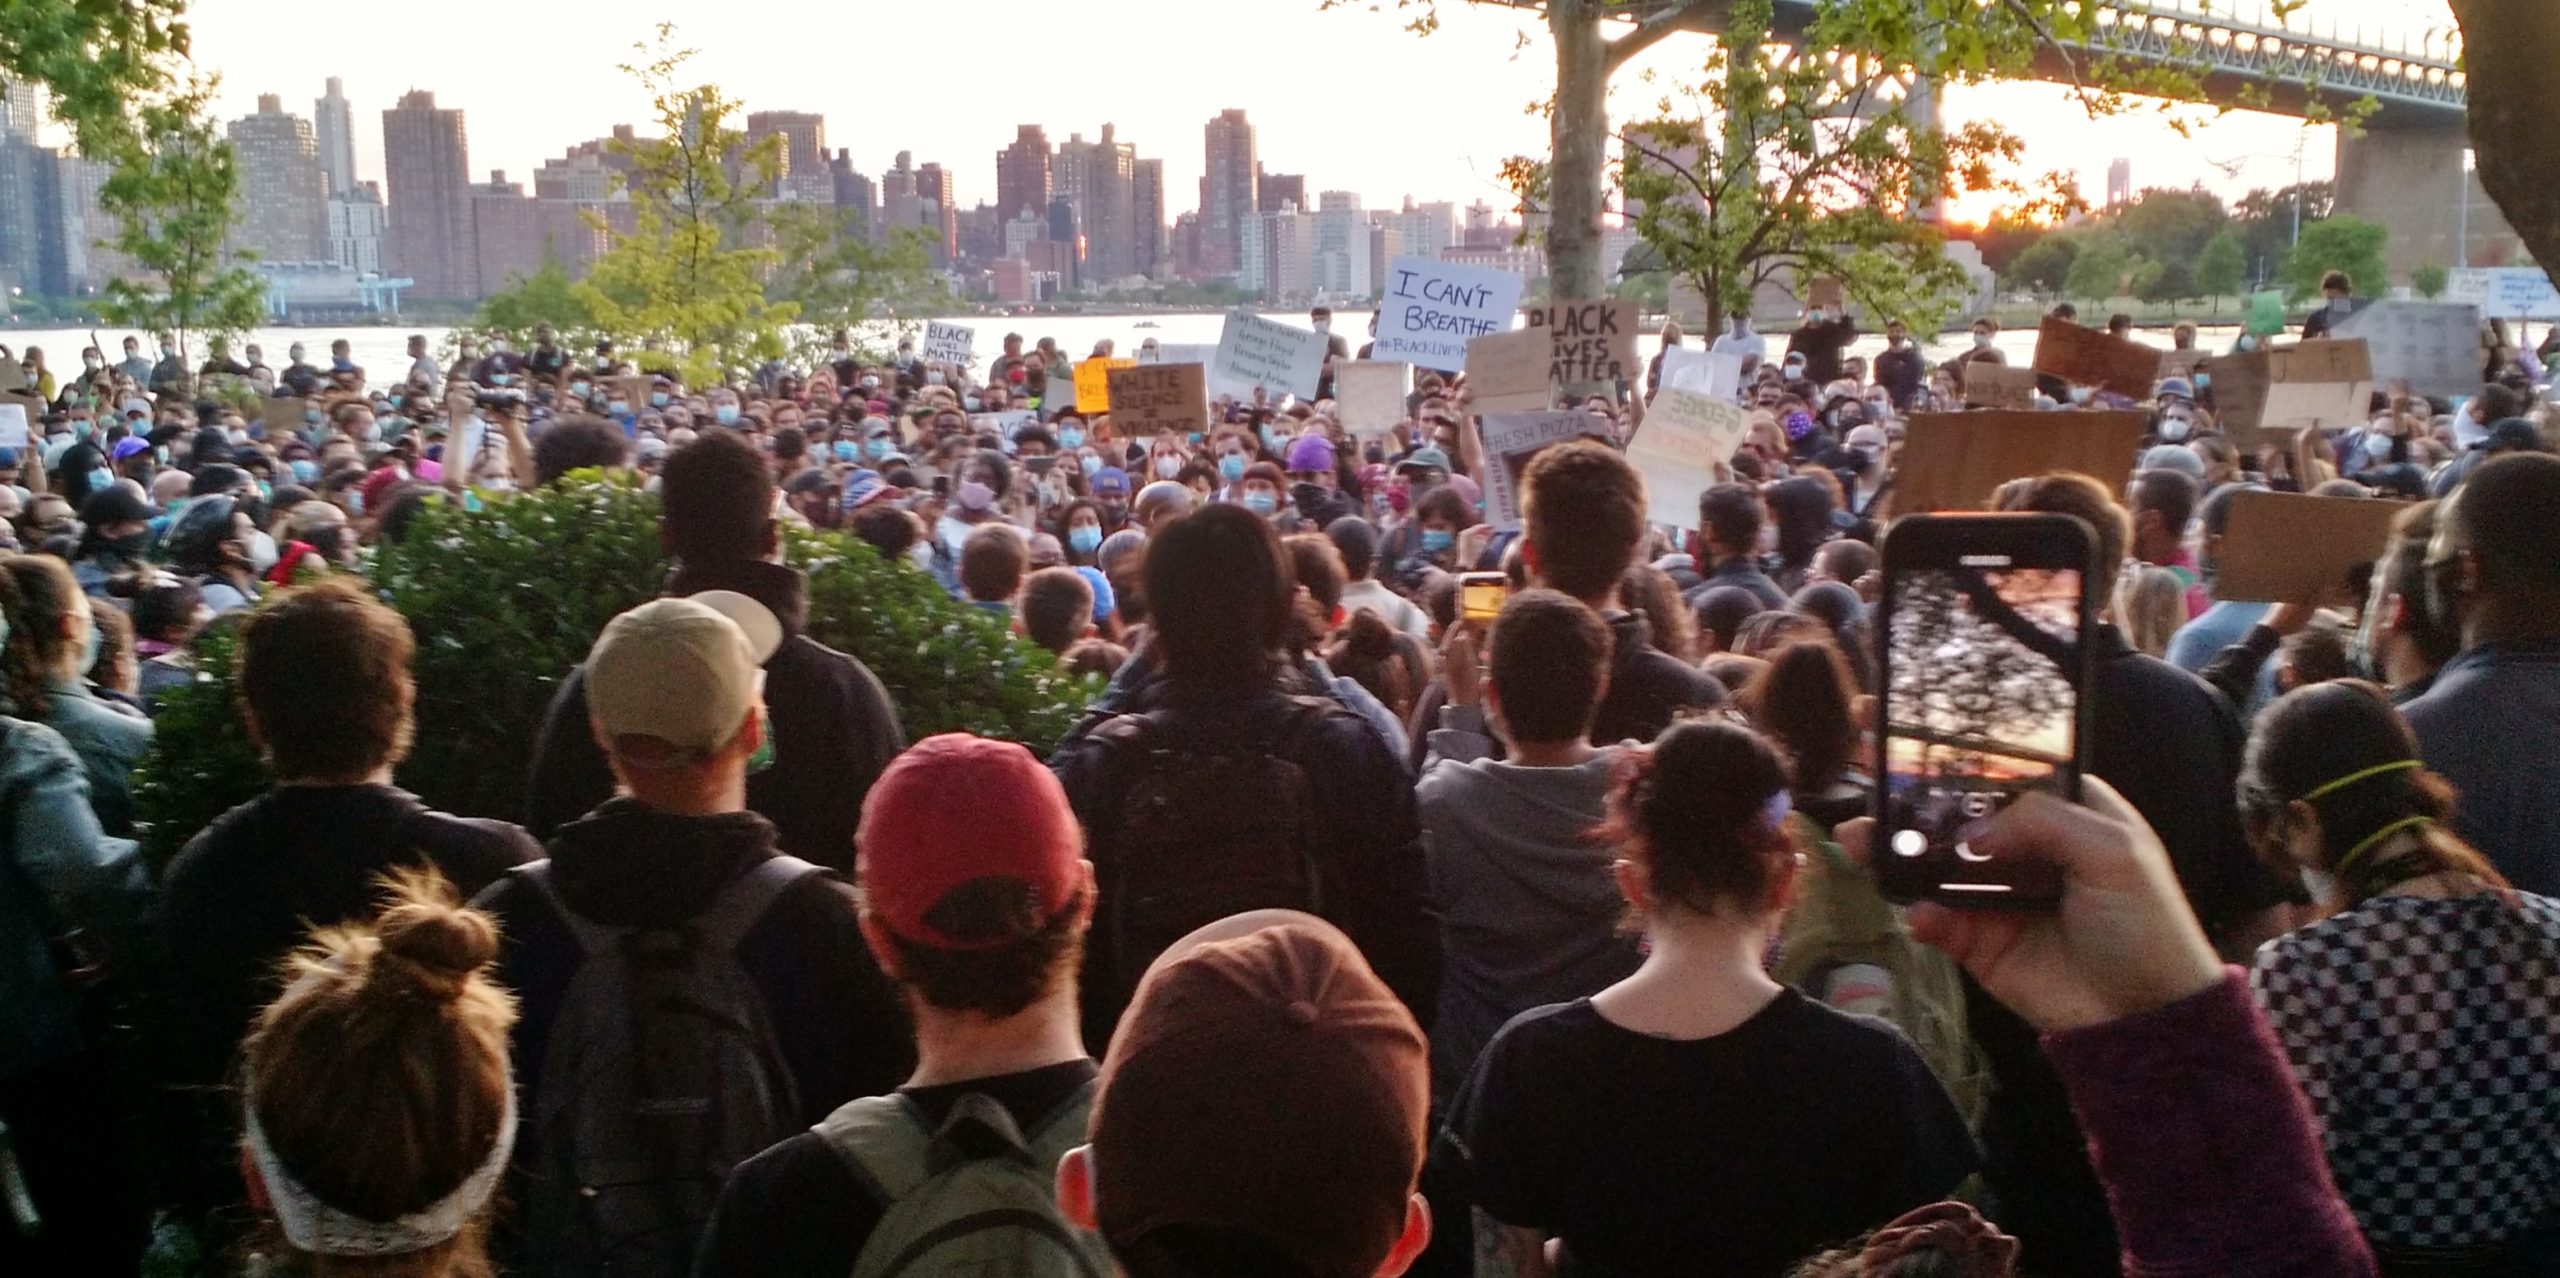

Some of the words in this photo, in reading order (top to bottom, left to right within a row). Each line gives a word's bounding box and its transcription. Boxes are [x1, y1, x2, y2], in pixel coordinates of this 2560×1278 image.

[1393, 269, 1419, 300] I
[1423, 278, 1493, 309] CAN'T
[1529, 303, 1618, 337] BLACK
[928, 323, 974, 344] BLACK
[1551, 338, 1609, 361] IVES
[1114, 370, 1180, 393] WHITE
[1548, 359, 1623, 384] ATTER
[1115, 392, 1184, 410] SILENCE
[1486, 426, 1535, 452] FRESH
[1540, 416, 1587, 439] PIZZA
